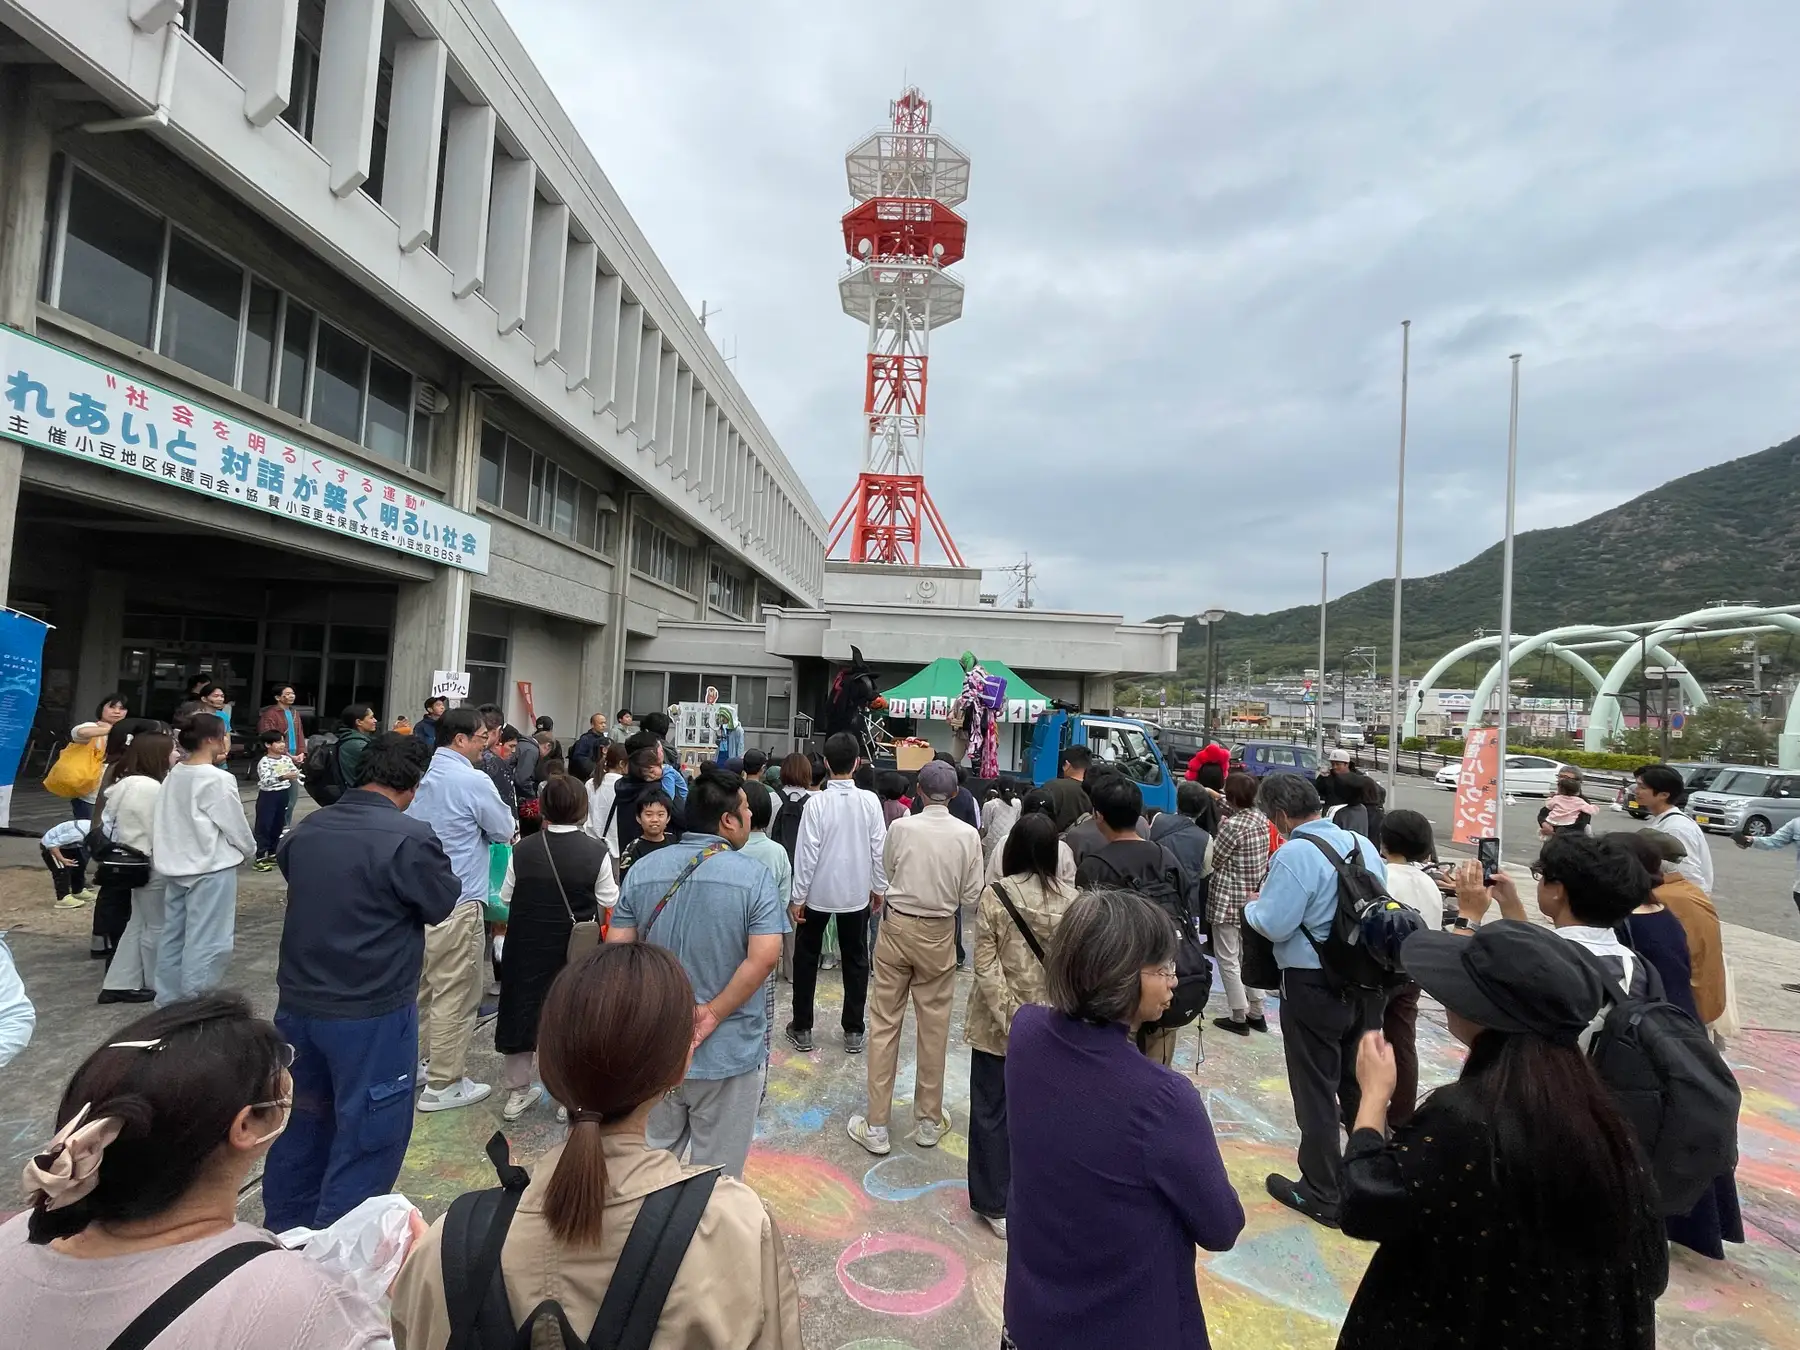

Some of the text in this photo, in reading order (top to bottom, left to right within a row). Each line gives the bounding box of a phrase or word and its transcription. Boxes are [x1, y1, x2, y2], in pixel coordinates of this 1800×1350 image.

[434, 681, 467, 695] ハロウィン
